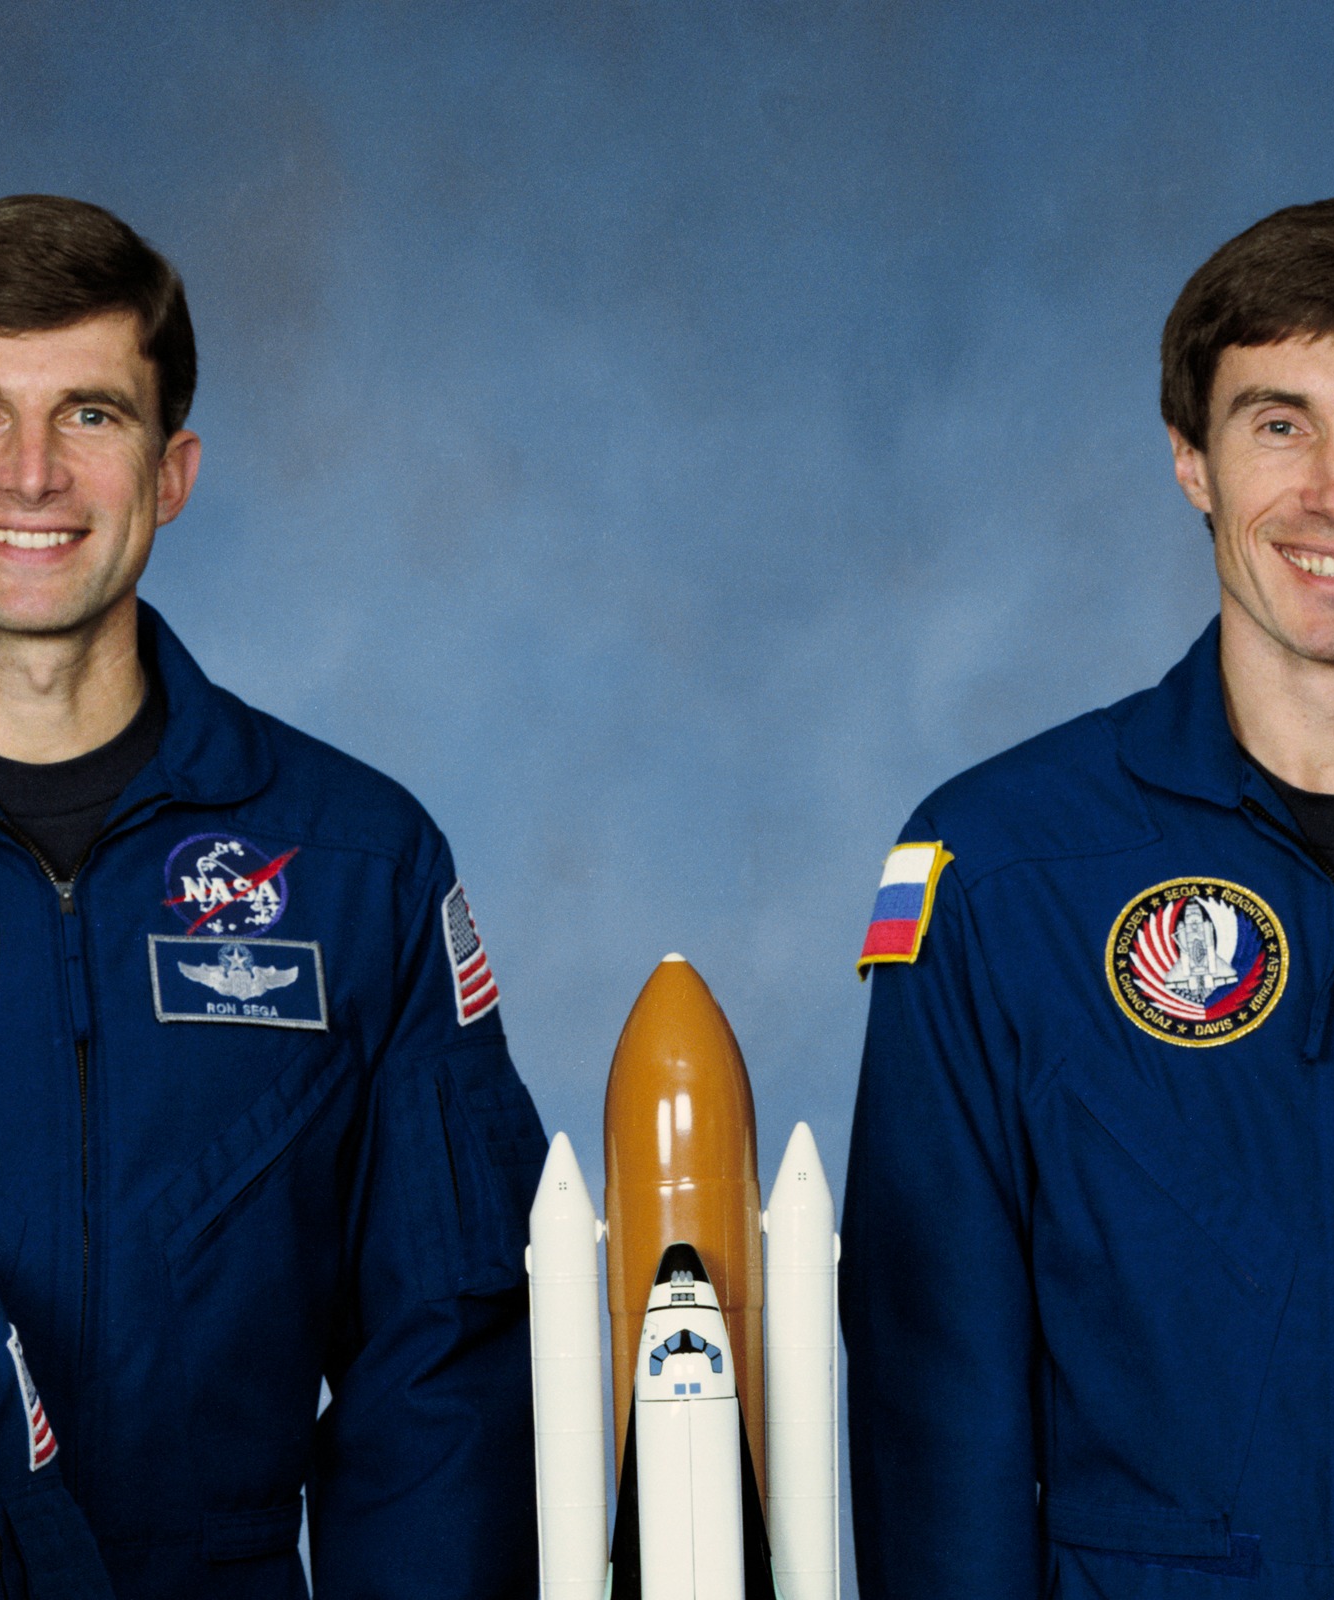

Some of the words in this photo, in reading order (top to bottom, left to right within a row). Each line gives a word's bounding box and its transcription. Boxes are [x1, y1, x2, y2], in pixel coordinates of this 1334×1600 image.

[181, 876, 280, 904] NASA
[1117, 908, 1148, 954] BOLDEN
[1164, 885, 1200, 901] SEGA
[1221, 889, 1274, 939] REIGHTLER
[206, 1002, 236, 1015] RON
[243, 1003, 279, 1017] SEGA
[1195, 1018, 1233, 1036] DAVIS
[1249, 957, 1279, 1012] KRIKALEV
